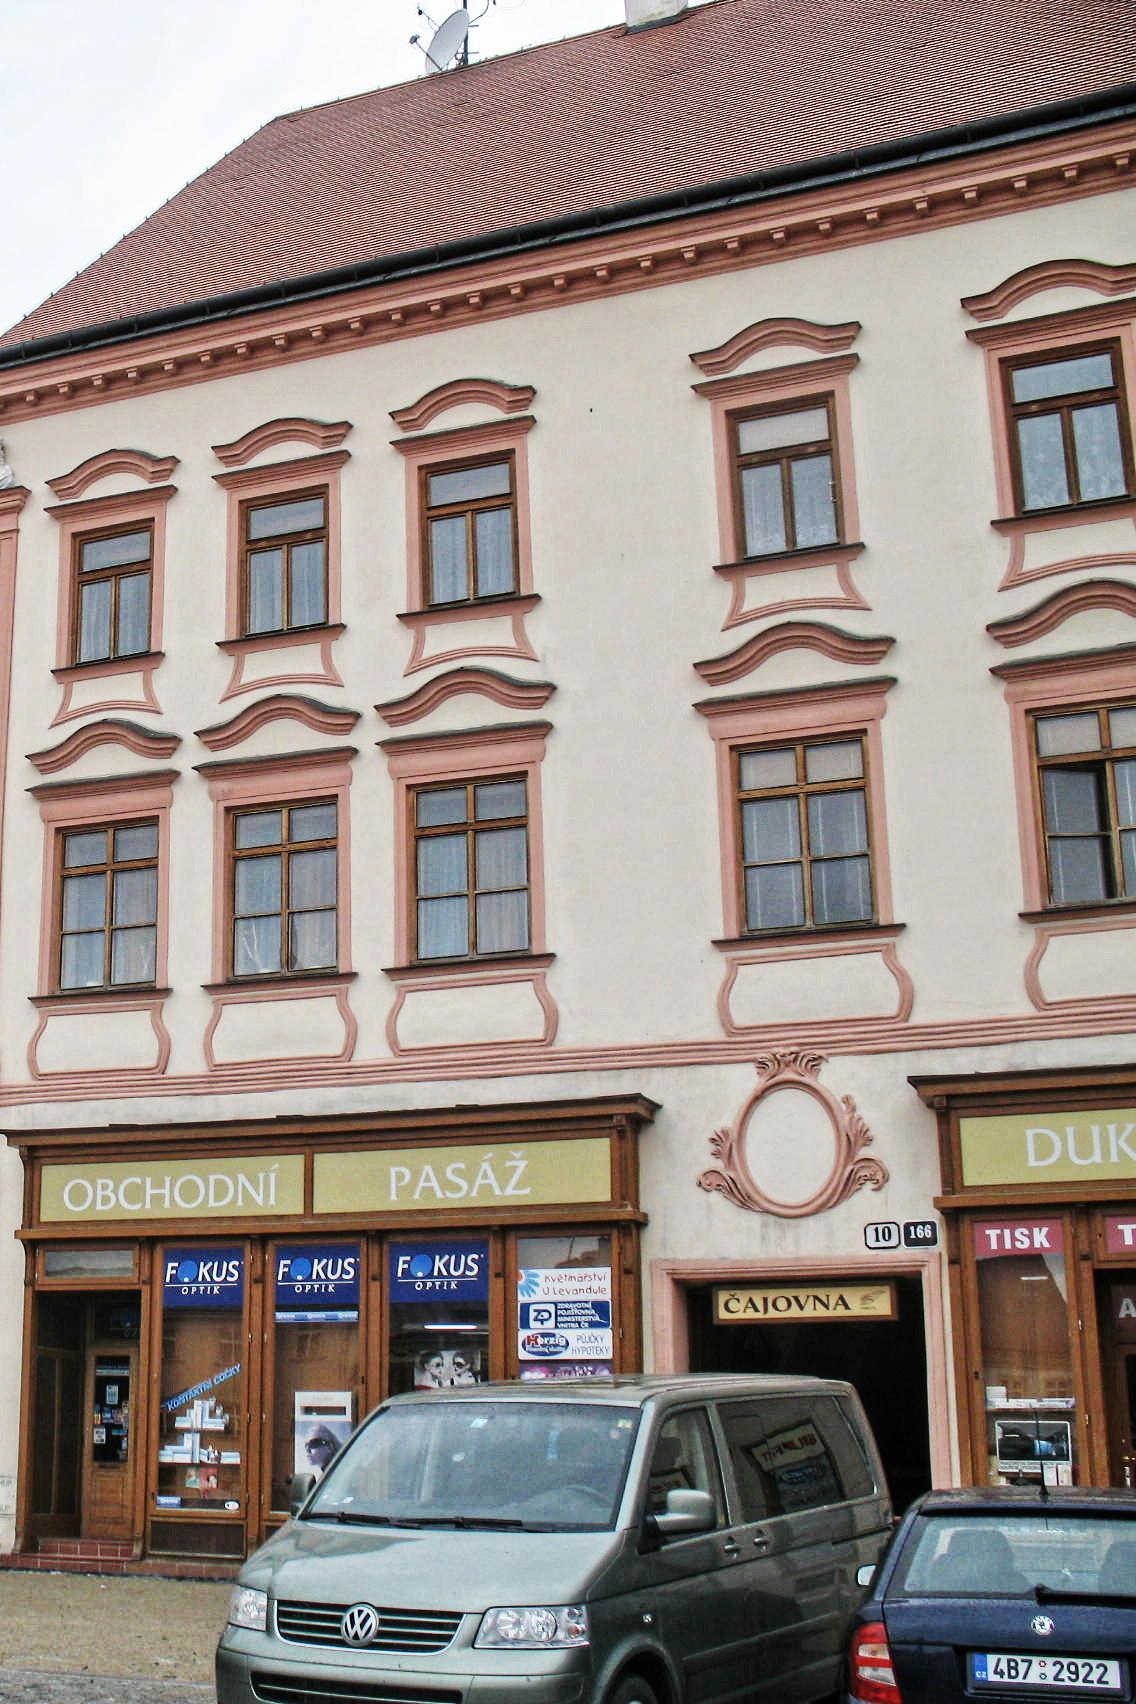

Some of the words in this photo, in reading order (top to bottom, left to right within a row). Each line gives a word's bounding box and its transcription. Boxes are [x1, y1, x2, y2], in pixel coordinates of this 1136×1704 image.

[63, 1163, 279, 1212] OBCHODNÍ
[389, 1151, 532, 1201] PASÁŽ
[874, 1226, 892, 1242] 10
[909, 1224, 932, 1239] 166
[985, 1227, 1051, 1250] TISK
[166, 1260, 240, 1283] FOKUS
[277, 1257, 356, 1281] FOKUS
[397, 1253, 480, 1278] FOKUS
[181, 1286, 221, 1296] OPTIK
[294, 1283, 336, 1294] OPTIK
[414, 1280, 458, 1291] OPTIK
[722, 1293, 851, 1315] ČAJOVNA
[526, 1334, 566, 1347] Herzig
[992, 1657, 1033, 1681] 4B7
[1052, 1660, 1109, 1686] 2922
